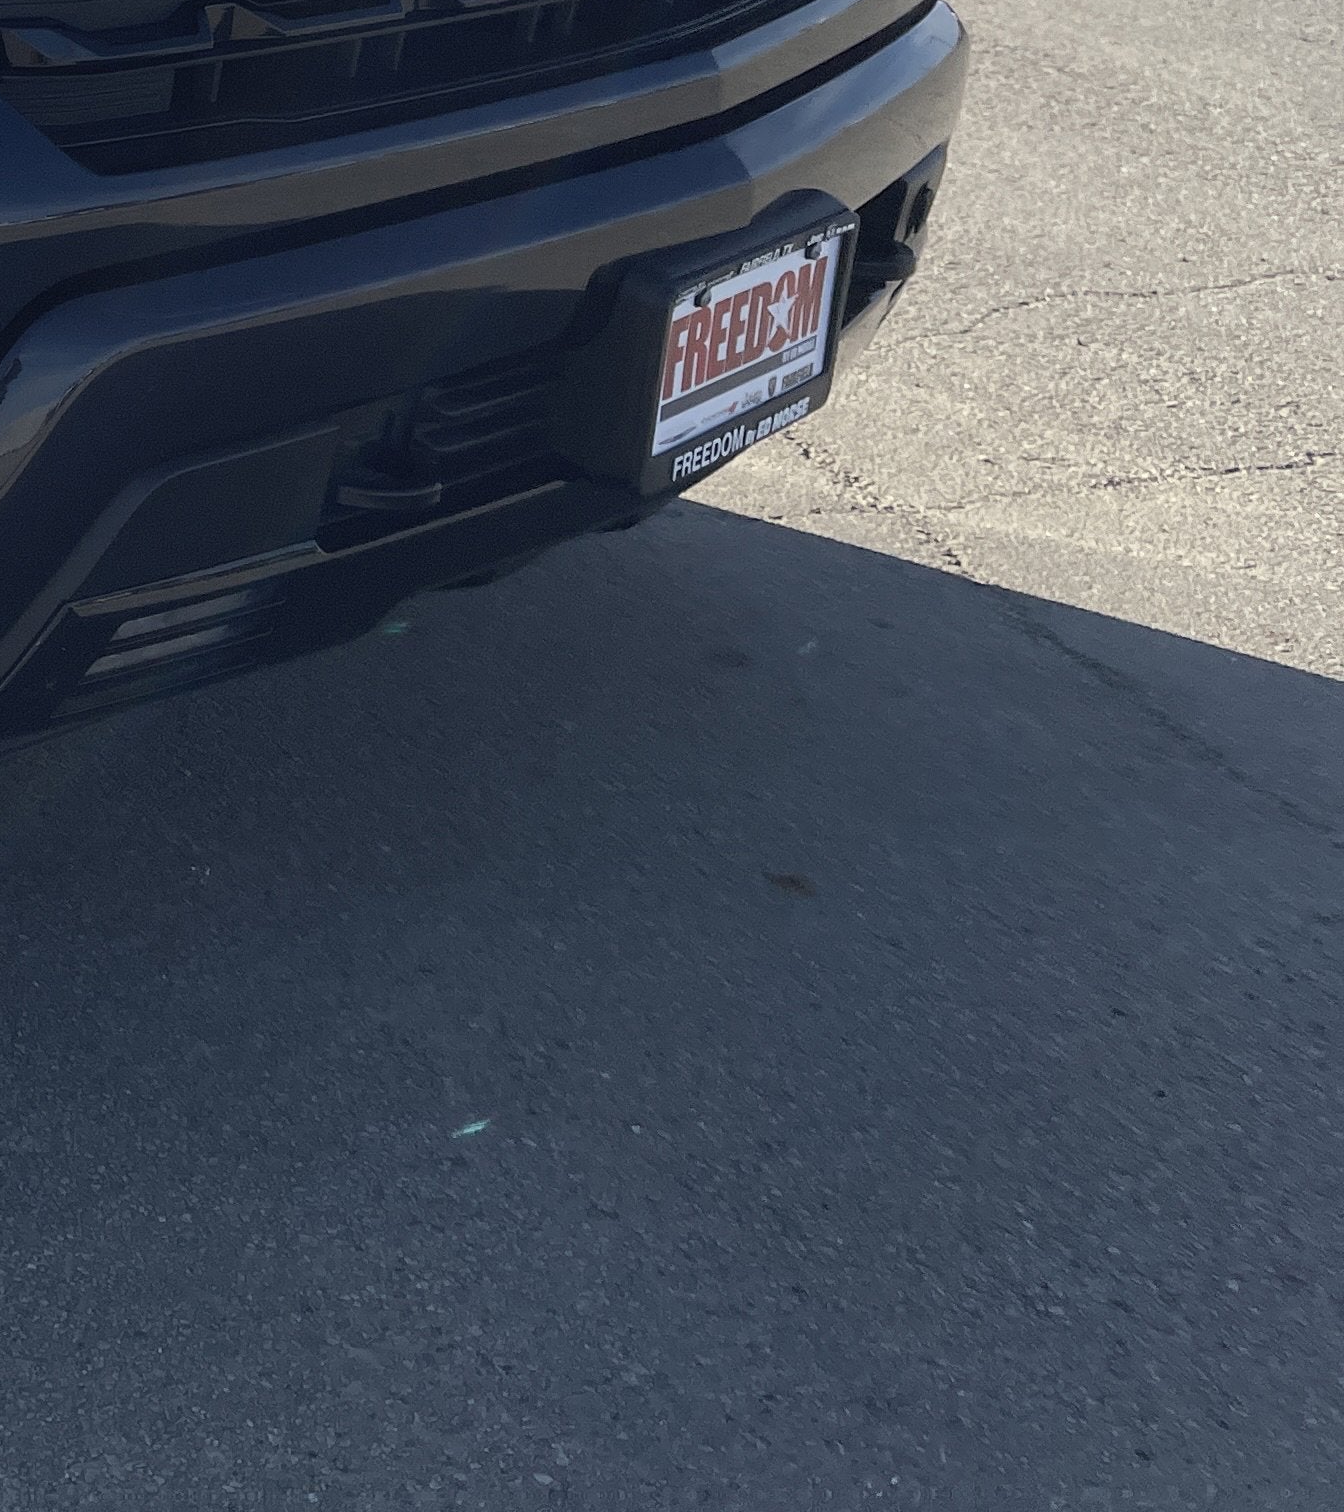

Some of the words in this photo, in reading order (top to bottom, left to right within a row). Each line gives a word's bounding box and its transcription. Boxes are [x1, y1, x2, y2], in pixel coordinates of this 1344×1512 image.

[662, 256, 829, 401] FREEDOM
[672, 425, 745, 482] FREEDOM
[756, 416, 772, 441] ED
[772, 396, 810, 432] MORSE
